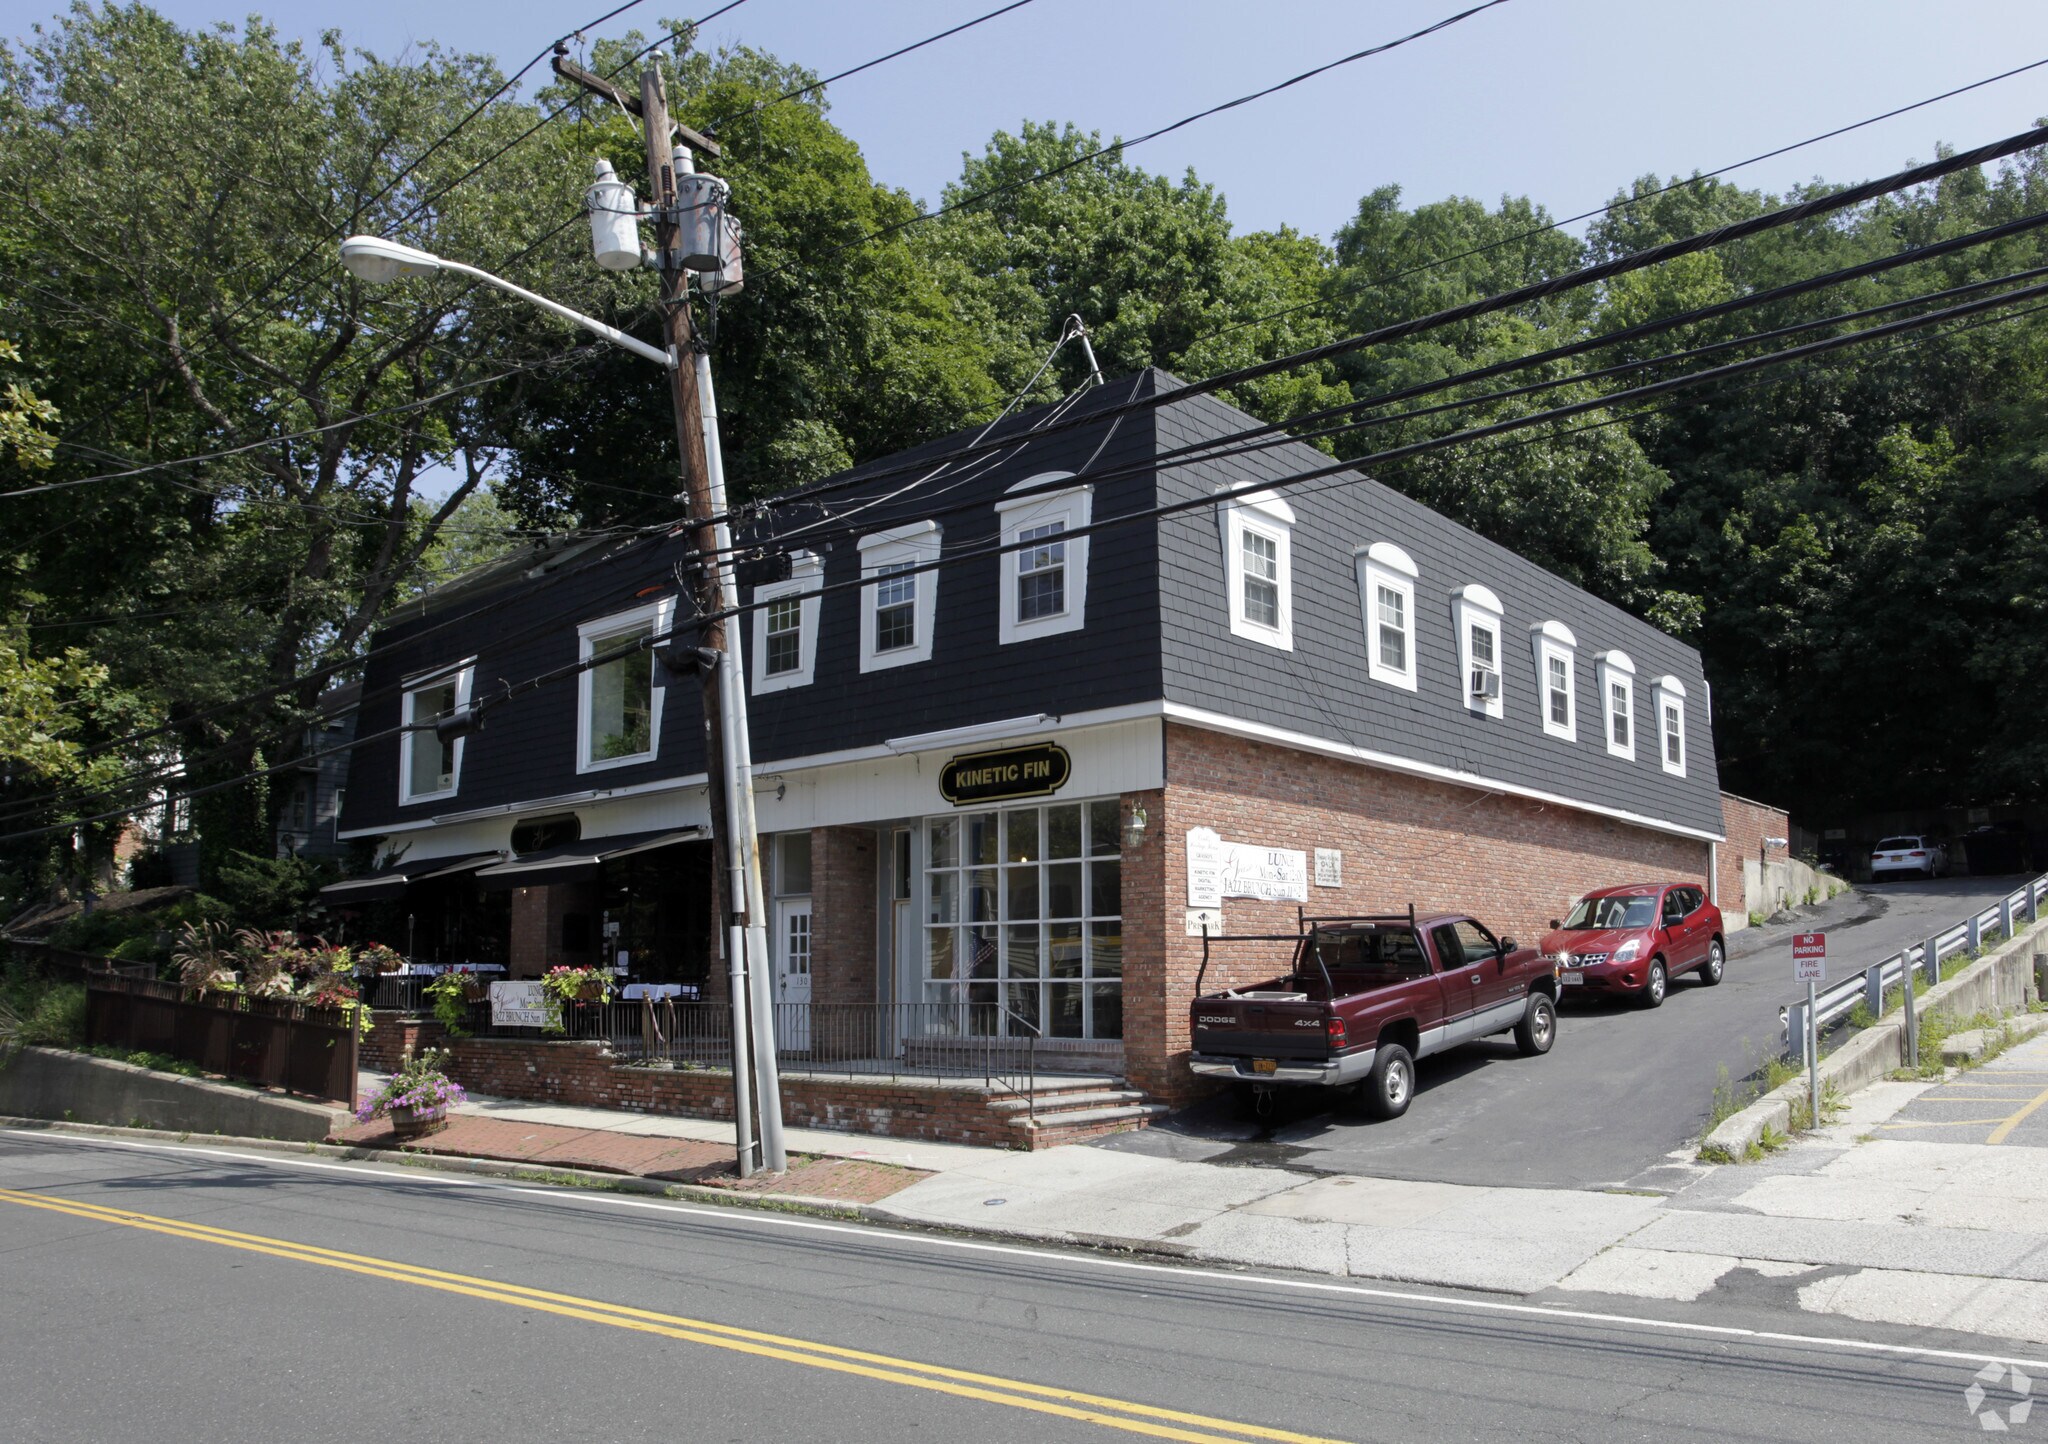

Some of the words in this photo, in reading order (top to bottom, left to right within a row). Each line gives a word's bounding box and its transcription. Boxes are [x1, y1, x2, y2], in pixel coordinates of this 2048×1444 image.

[956, 764, 1019, 788] KINETIC
[1024, 760, 1050, 779] FIN
[1268, 852, 1295, 867] LUNCH
[1224, 877, 1242, 893] JAZZ
[1243, 880, 1272, 896] BRUNCH
[1187, 920, 1220, 931] PRISARK
[1803, 936, 1814, 944] NO
[1794, 945, 1824, 954] PARKING
[1800, 960, 1819, 968] FIRE
[1799, 970, 1821, 978] LANE
[796, 977, 808, 986] 130
[505, 1011, 530, 1023] BRUNCH
[530, 1012, 541, 1023] Sun
[1199, 1015, 1236, 1024] DODGE
